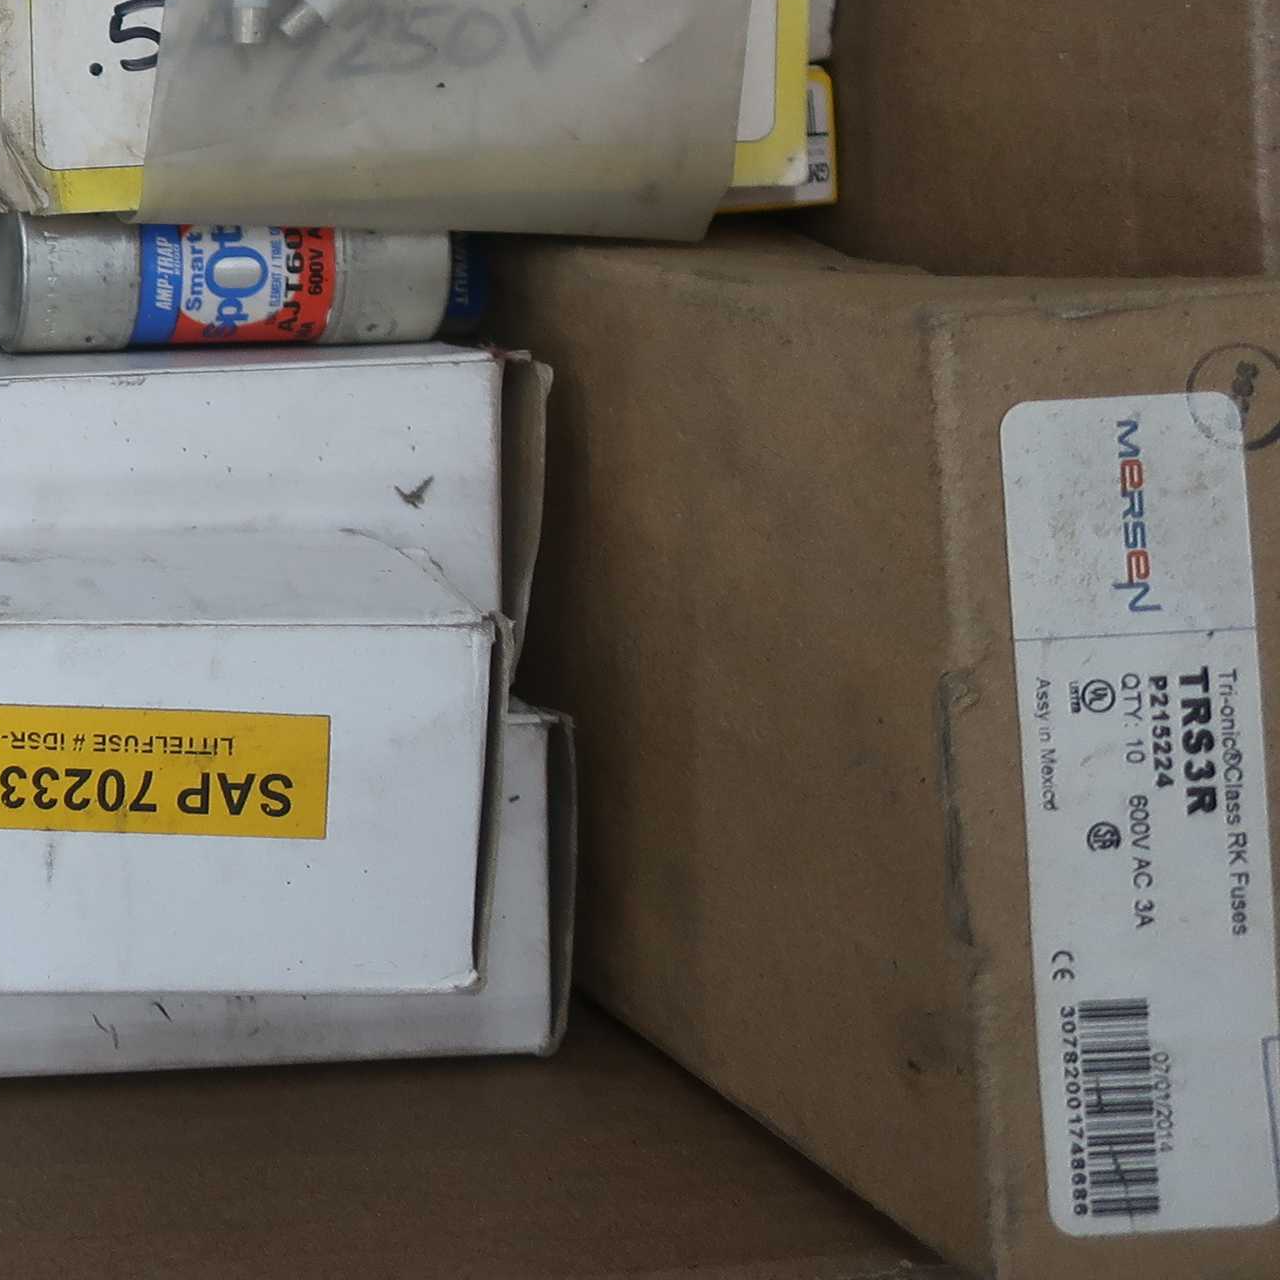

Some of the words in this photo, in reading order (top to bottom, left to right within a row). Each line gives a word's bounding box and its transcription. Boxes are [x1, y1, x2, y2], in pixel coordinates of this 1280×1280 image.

[155, 236, 169, 311] AMP-TRAP
[186, 232, 204, 312] Smart
[278, 228, 304, 332] AJT60
[308, 249, 324, 295] 600V
[1113, 420, 1162, 613] MERSEN
[93, 734, 233, 755] LITTELFUSE
[1148, 676, 1174, 789] P215224
[1179, 666, 1216, 816] TRS3R
[176, 772, 294, 817] SAP
[1040, 748, 1058, 812] Mexico
[1129, 795, 1151, 853] 600V
[1228, 831, 1248, 864] RK
[1132, 857, 1152, 889] AC
[1230, 870, 1249, 936] Fuses
[1134, 897, 1155, 929] 3A
